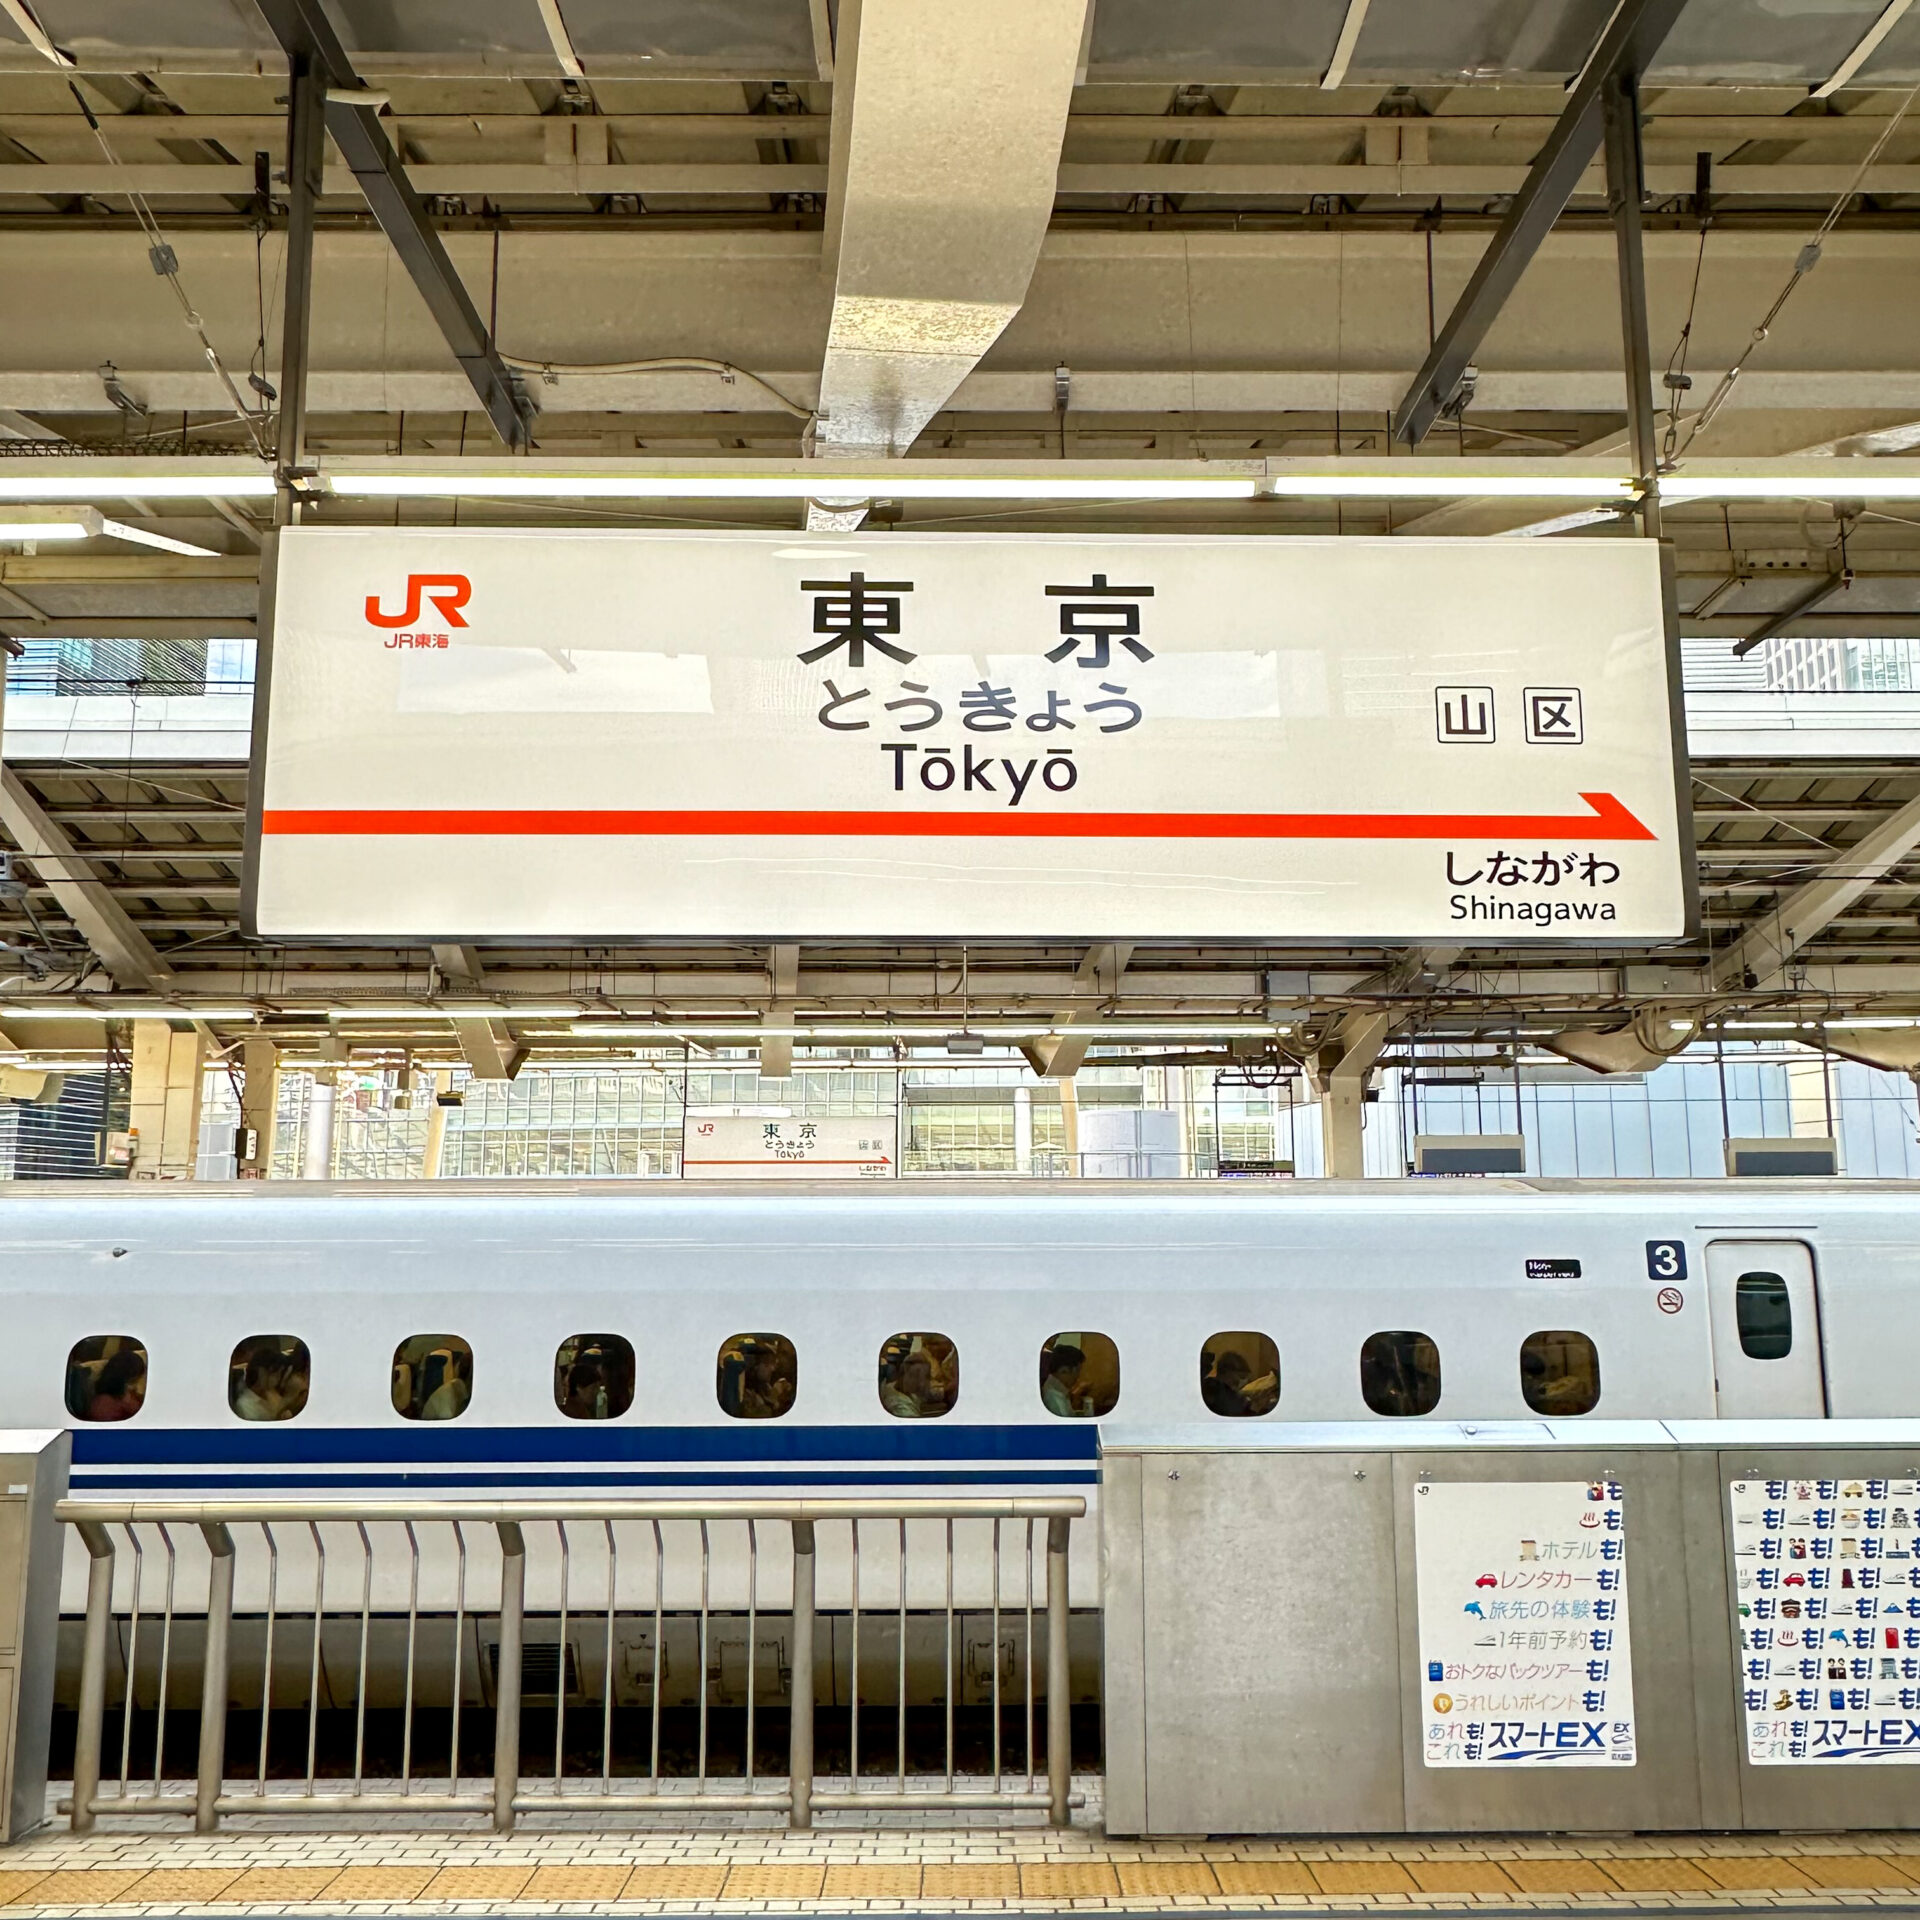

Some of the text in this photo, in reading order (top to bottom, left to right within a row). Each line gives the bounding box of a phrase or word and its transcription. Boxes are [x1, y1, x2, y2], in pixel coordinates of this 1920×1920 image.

[365, 574, 472, 628] JR
[384, 633, 449, 649] JR東海
[818, 679, 1143, 733] とうきょう
[1444, 694, 1576, 737] 山 区
[881, 743, 1078, 807] Tōkyō
[1446, 851, 1620, 887] しながわ
[1450, 894, 1616, 926] Shinagawa
[1655, 1245, 1678, 1276] 3
[1488, 1722, 1608, 1748] スマートEX
